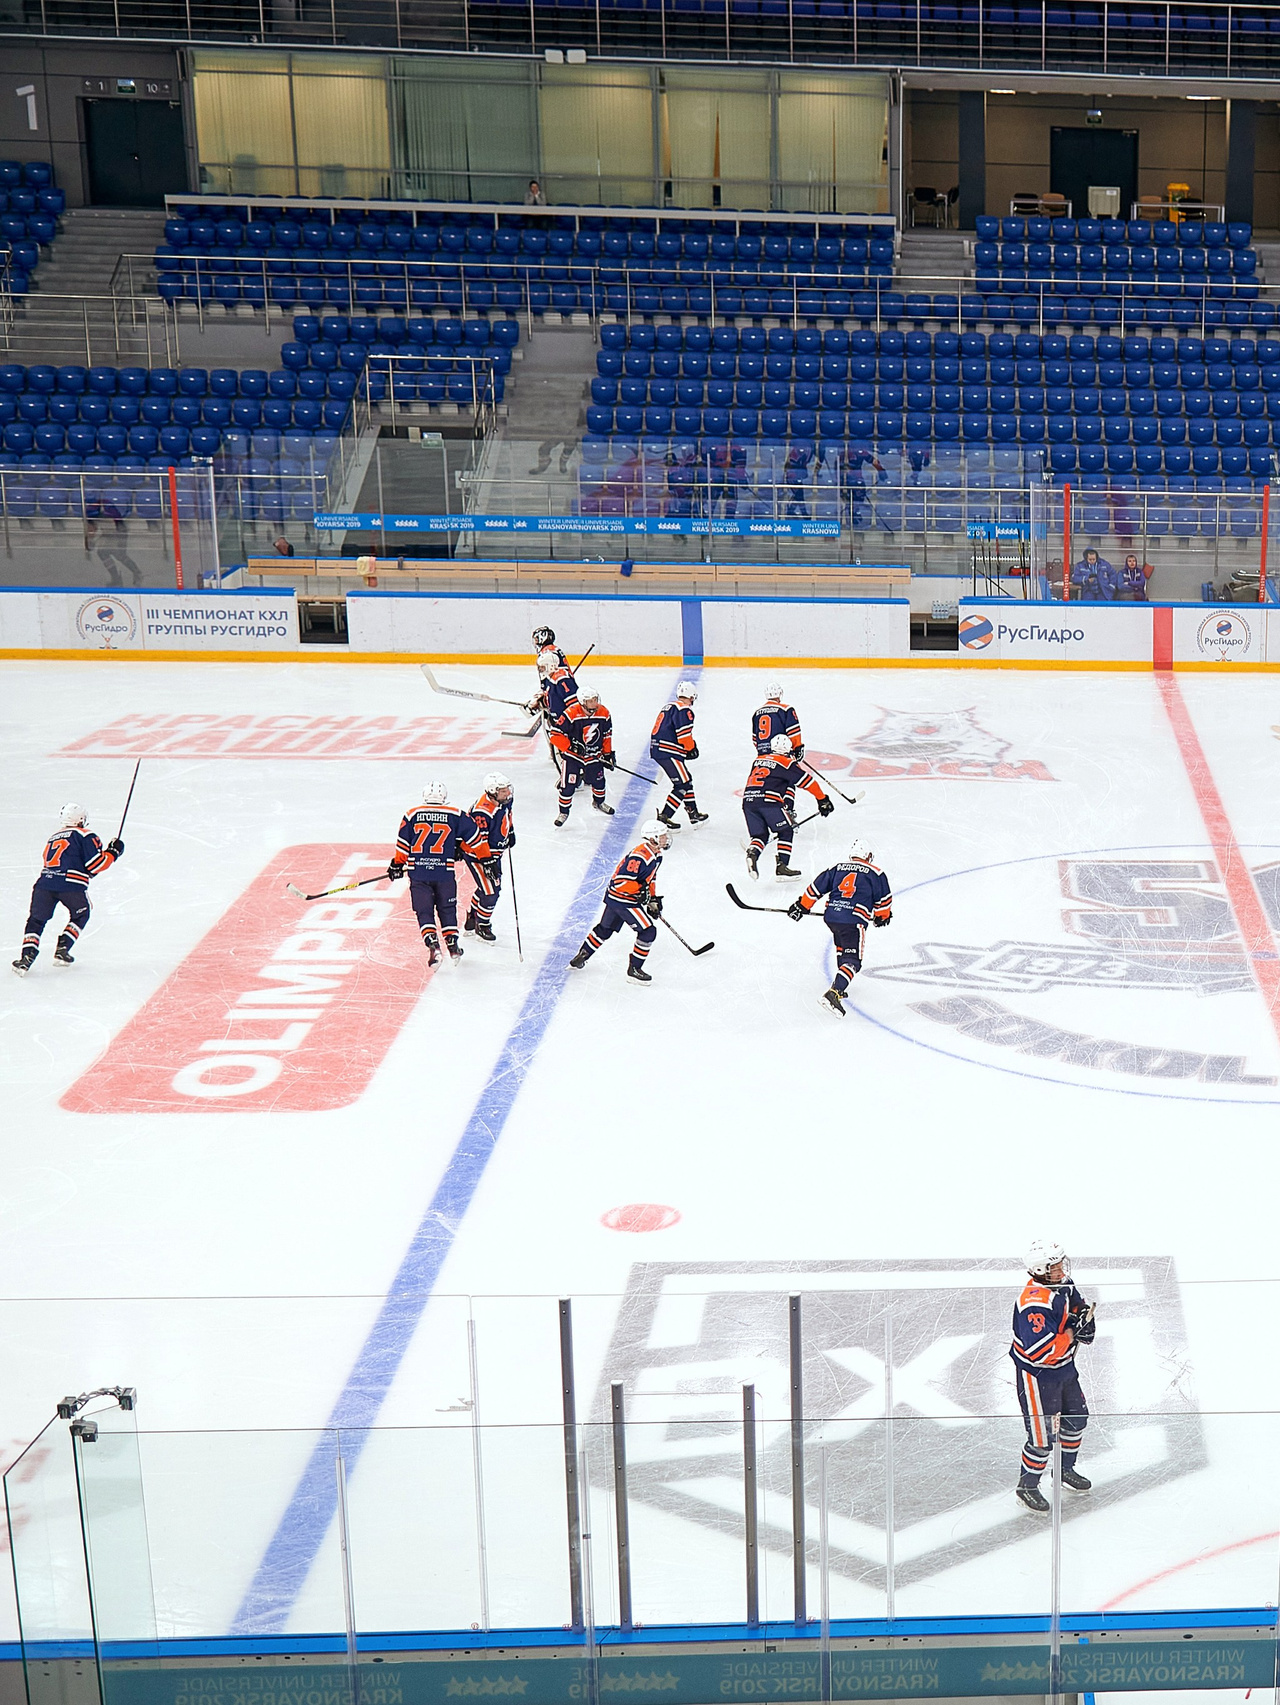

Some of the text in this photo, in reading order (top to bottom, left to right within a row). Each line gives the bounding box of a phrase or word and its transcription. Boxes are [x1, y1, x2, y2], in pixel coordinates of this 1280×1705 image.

[98, 81, 104, 91] 1
[146, 83, 158, 93] 10
[16, 84, 38, 130] 1
[146, 609, 289, 621] III ЧЕМПИОНАТ КХЛ
[85, 623, 128, 633] РусГидро
[147, 625, 287, 638] ГРУППЫ РУСГИДРО
[998, 624, 1085, 642] РусГидро
[1204, 637, 1244, 647] РусГидро
[102, 713, 459, 732] КРАСНАЯ
[758, 714, 771, 740] 9
[61, 729, 541, 755] МАШИНА
[416, 812, 449, 823] ИГОНИН
[411, 822, 452, 854] 77
[838, 872, 858, 899] 4
[170, 852, 411, 1097] OLIMPBET
[906, 993, 1278, 1086] SOKOL
